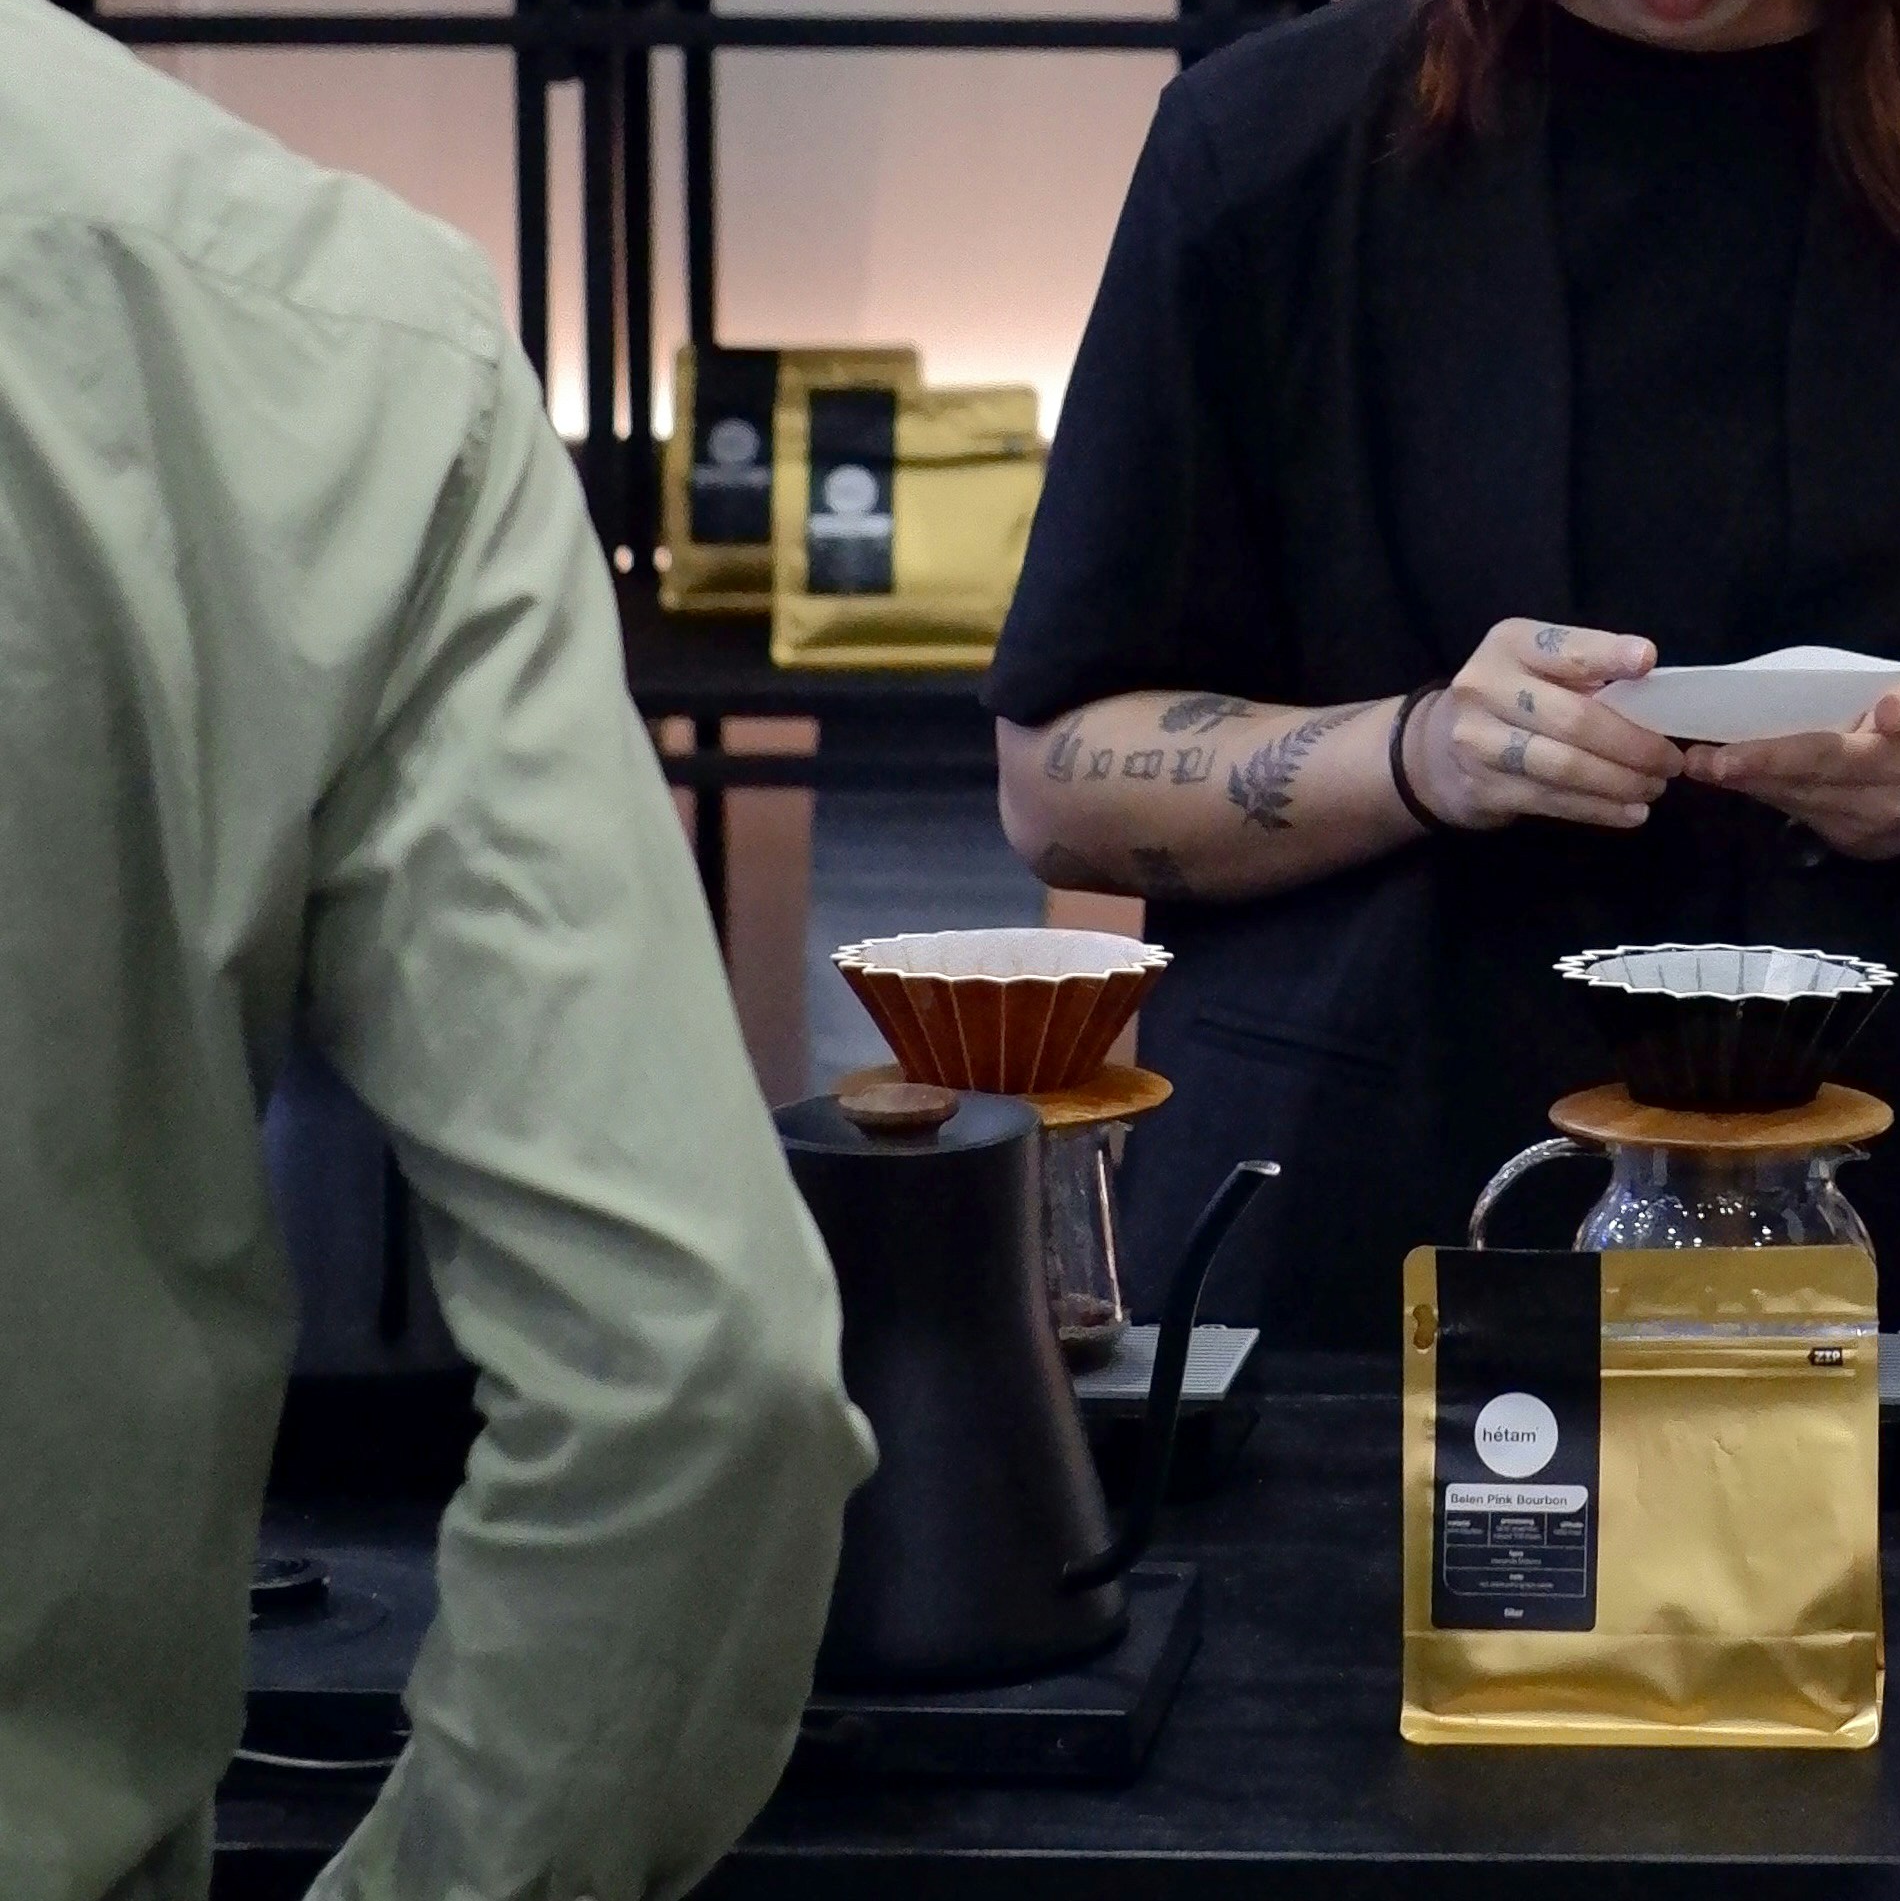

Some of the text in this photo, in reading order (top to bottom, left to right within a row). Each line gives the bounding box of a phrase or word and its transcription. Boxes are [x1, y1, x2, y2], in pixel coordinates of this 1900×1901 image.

[1482, 1425, 1537, 1443] hétam
[1450, 1493, 1568, 1506] Belen Pink Bourbon
